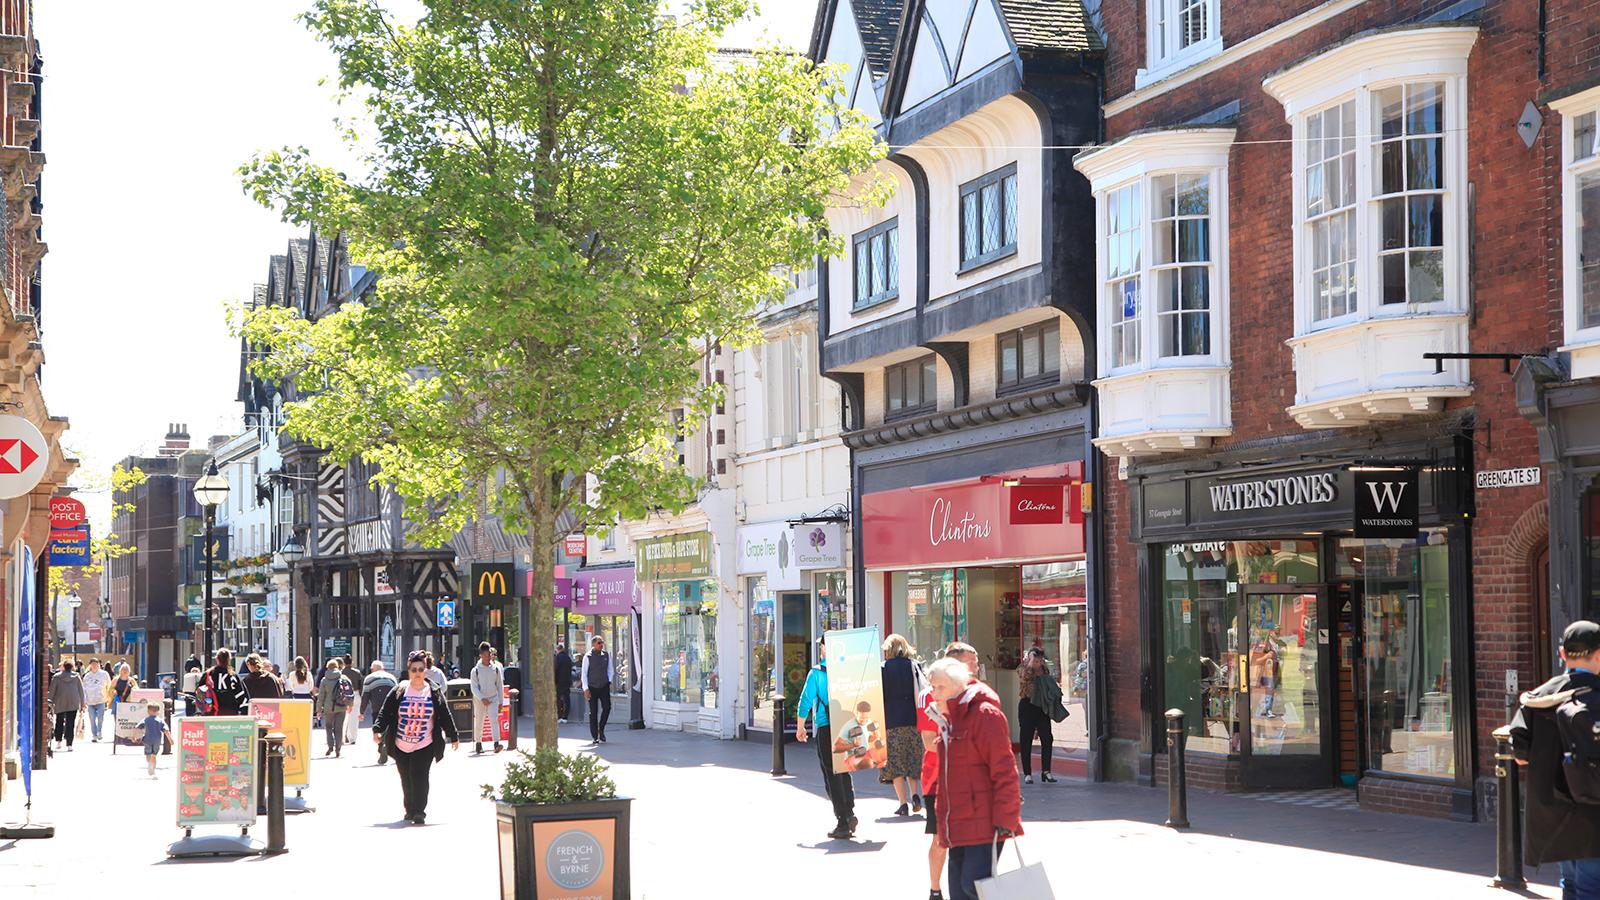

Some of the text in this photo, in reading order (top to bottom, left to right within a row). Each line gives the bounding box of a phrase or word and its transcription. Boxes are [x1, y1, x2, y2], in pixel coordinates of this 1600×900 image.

[1478, 468, 1538, 486] GREENGATE ST
[1208, 472, 1335, 513] WATERSTONES
[1365, 481, 1408, 513] W
[52, 503, 77, 511] POST
[1017, 499, 1056, 512] Clintons
[930, 497, 992, 546] Clintons
[51, 544, 86, 556] factory
[745, 538, 776, 561] Grape Tree
[800, 554, 837, 564] Grape Tree
[598, 581, 615, 595] POLKA
[615, 580, 625, 594] DOT
[943, 595, 965, 616] NEW
[183, 730, 204, 738] Half
[182, 738, 205, 747] Price
[556, 845, 593, 856] FRENCH
[571, 855, 578, 864] &
[560, 864, 590, 875] BYRNE
